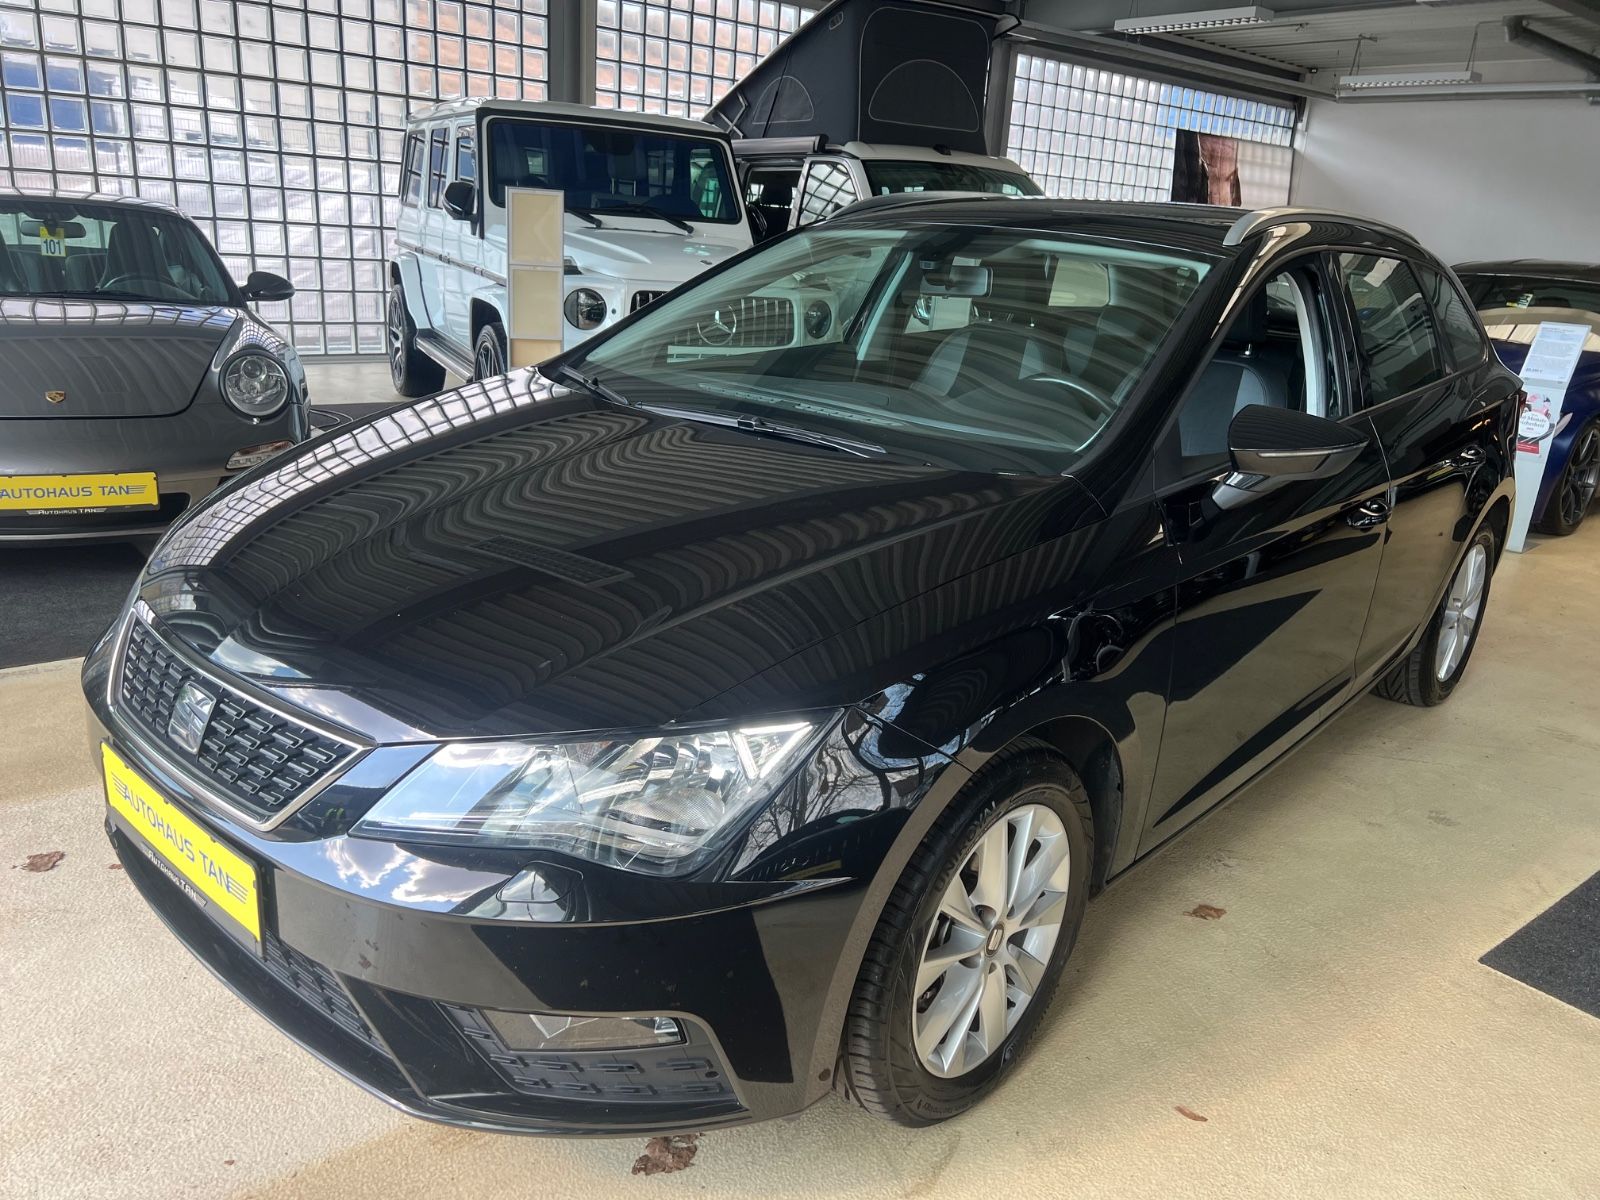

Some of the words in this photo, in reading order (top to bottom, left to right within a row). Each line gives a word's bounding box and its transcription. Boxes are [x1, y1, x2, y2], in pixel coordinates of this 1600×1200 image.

[43, 239, 61, 255] 101
[0, 487, 92, 499] AUTOHAUS
[98, 485, 129, 496] TAN
[124, 785, 195, 862] AUTOHAUS
[199, 850, 233, 892] TAN
